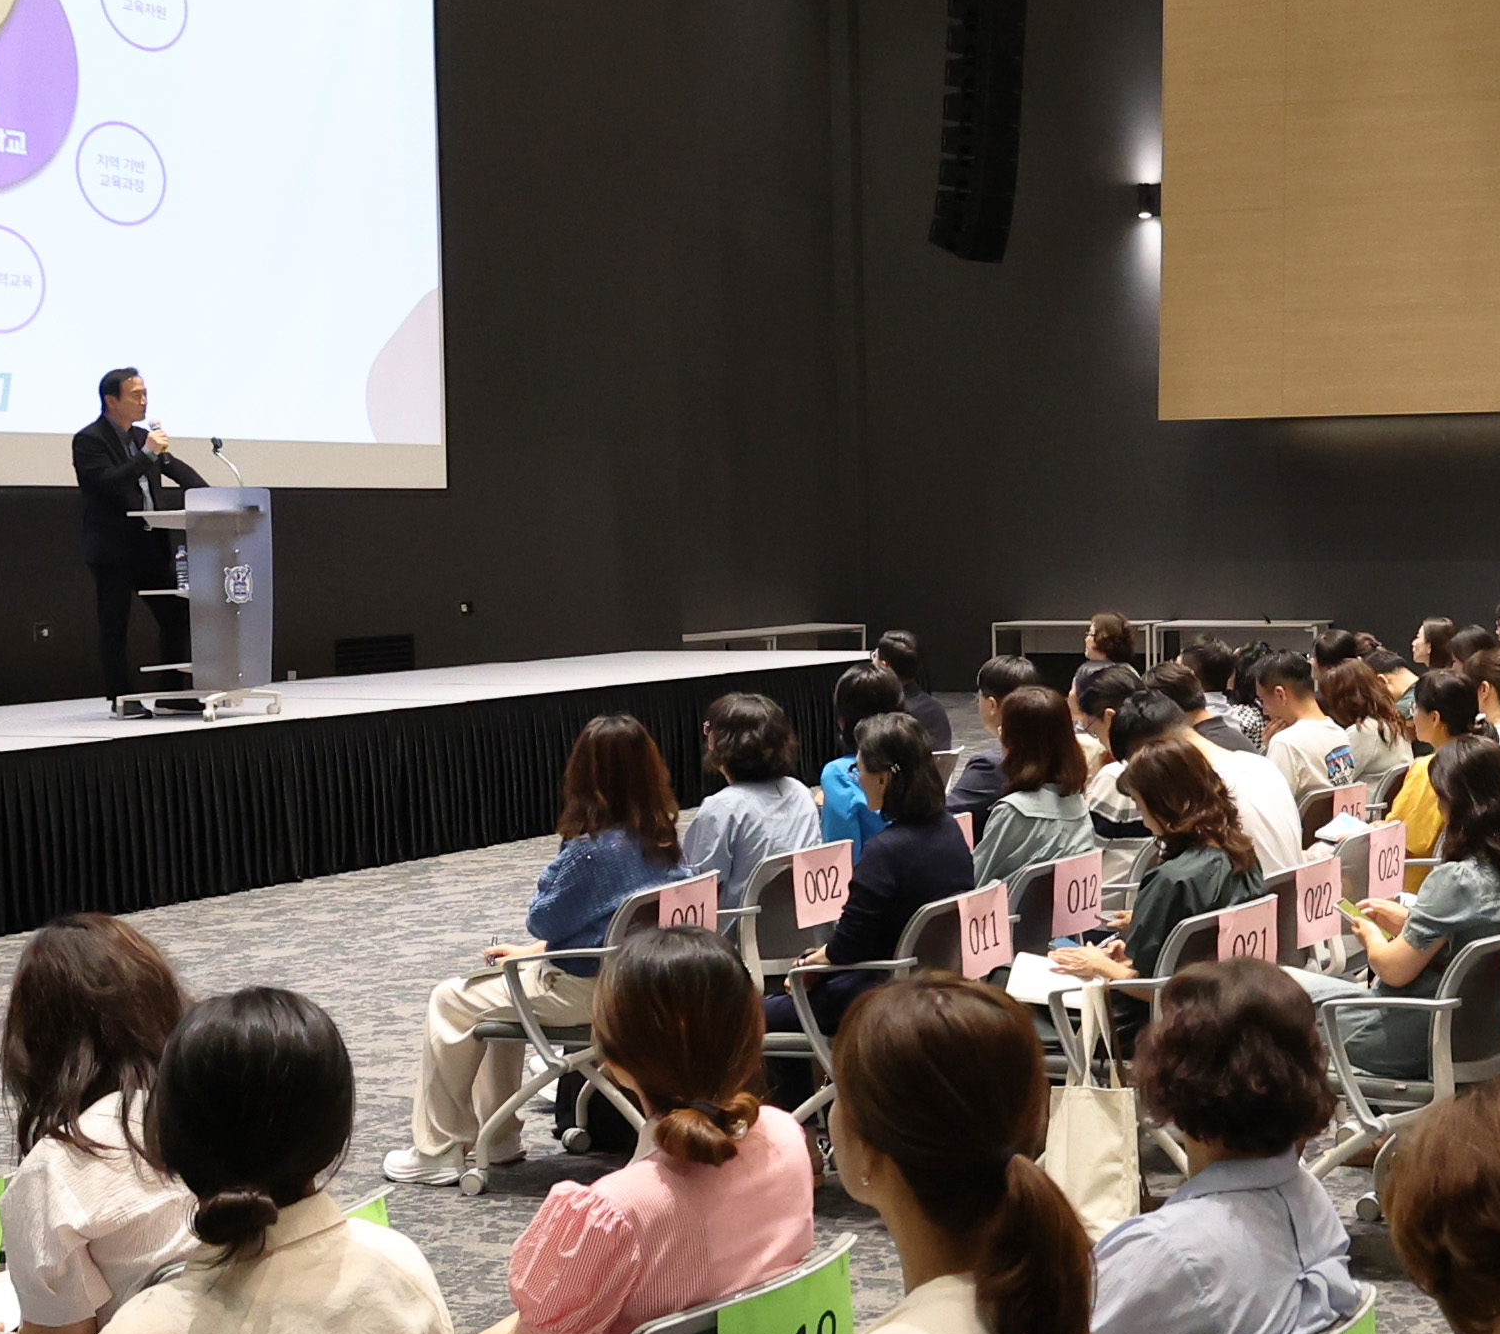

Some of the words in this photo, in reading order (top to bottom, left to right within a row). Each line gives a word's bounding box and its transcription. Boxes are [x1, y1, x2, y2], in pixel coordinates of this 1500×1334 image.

[97, 153, 121, 171] 지역
[123, 157, 146, 174] 기반
[99, 174, 145, 194] 교육과정
[1377, 845, 1401, 882] 023
[804, 865, 842, 905] 002
[1066, 872, 1098, 916] 012
[1303, 882, 1334, 924] 022
[967, 909, 1001, 956] 011
